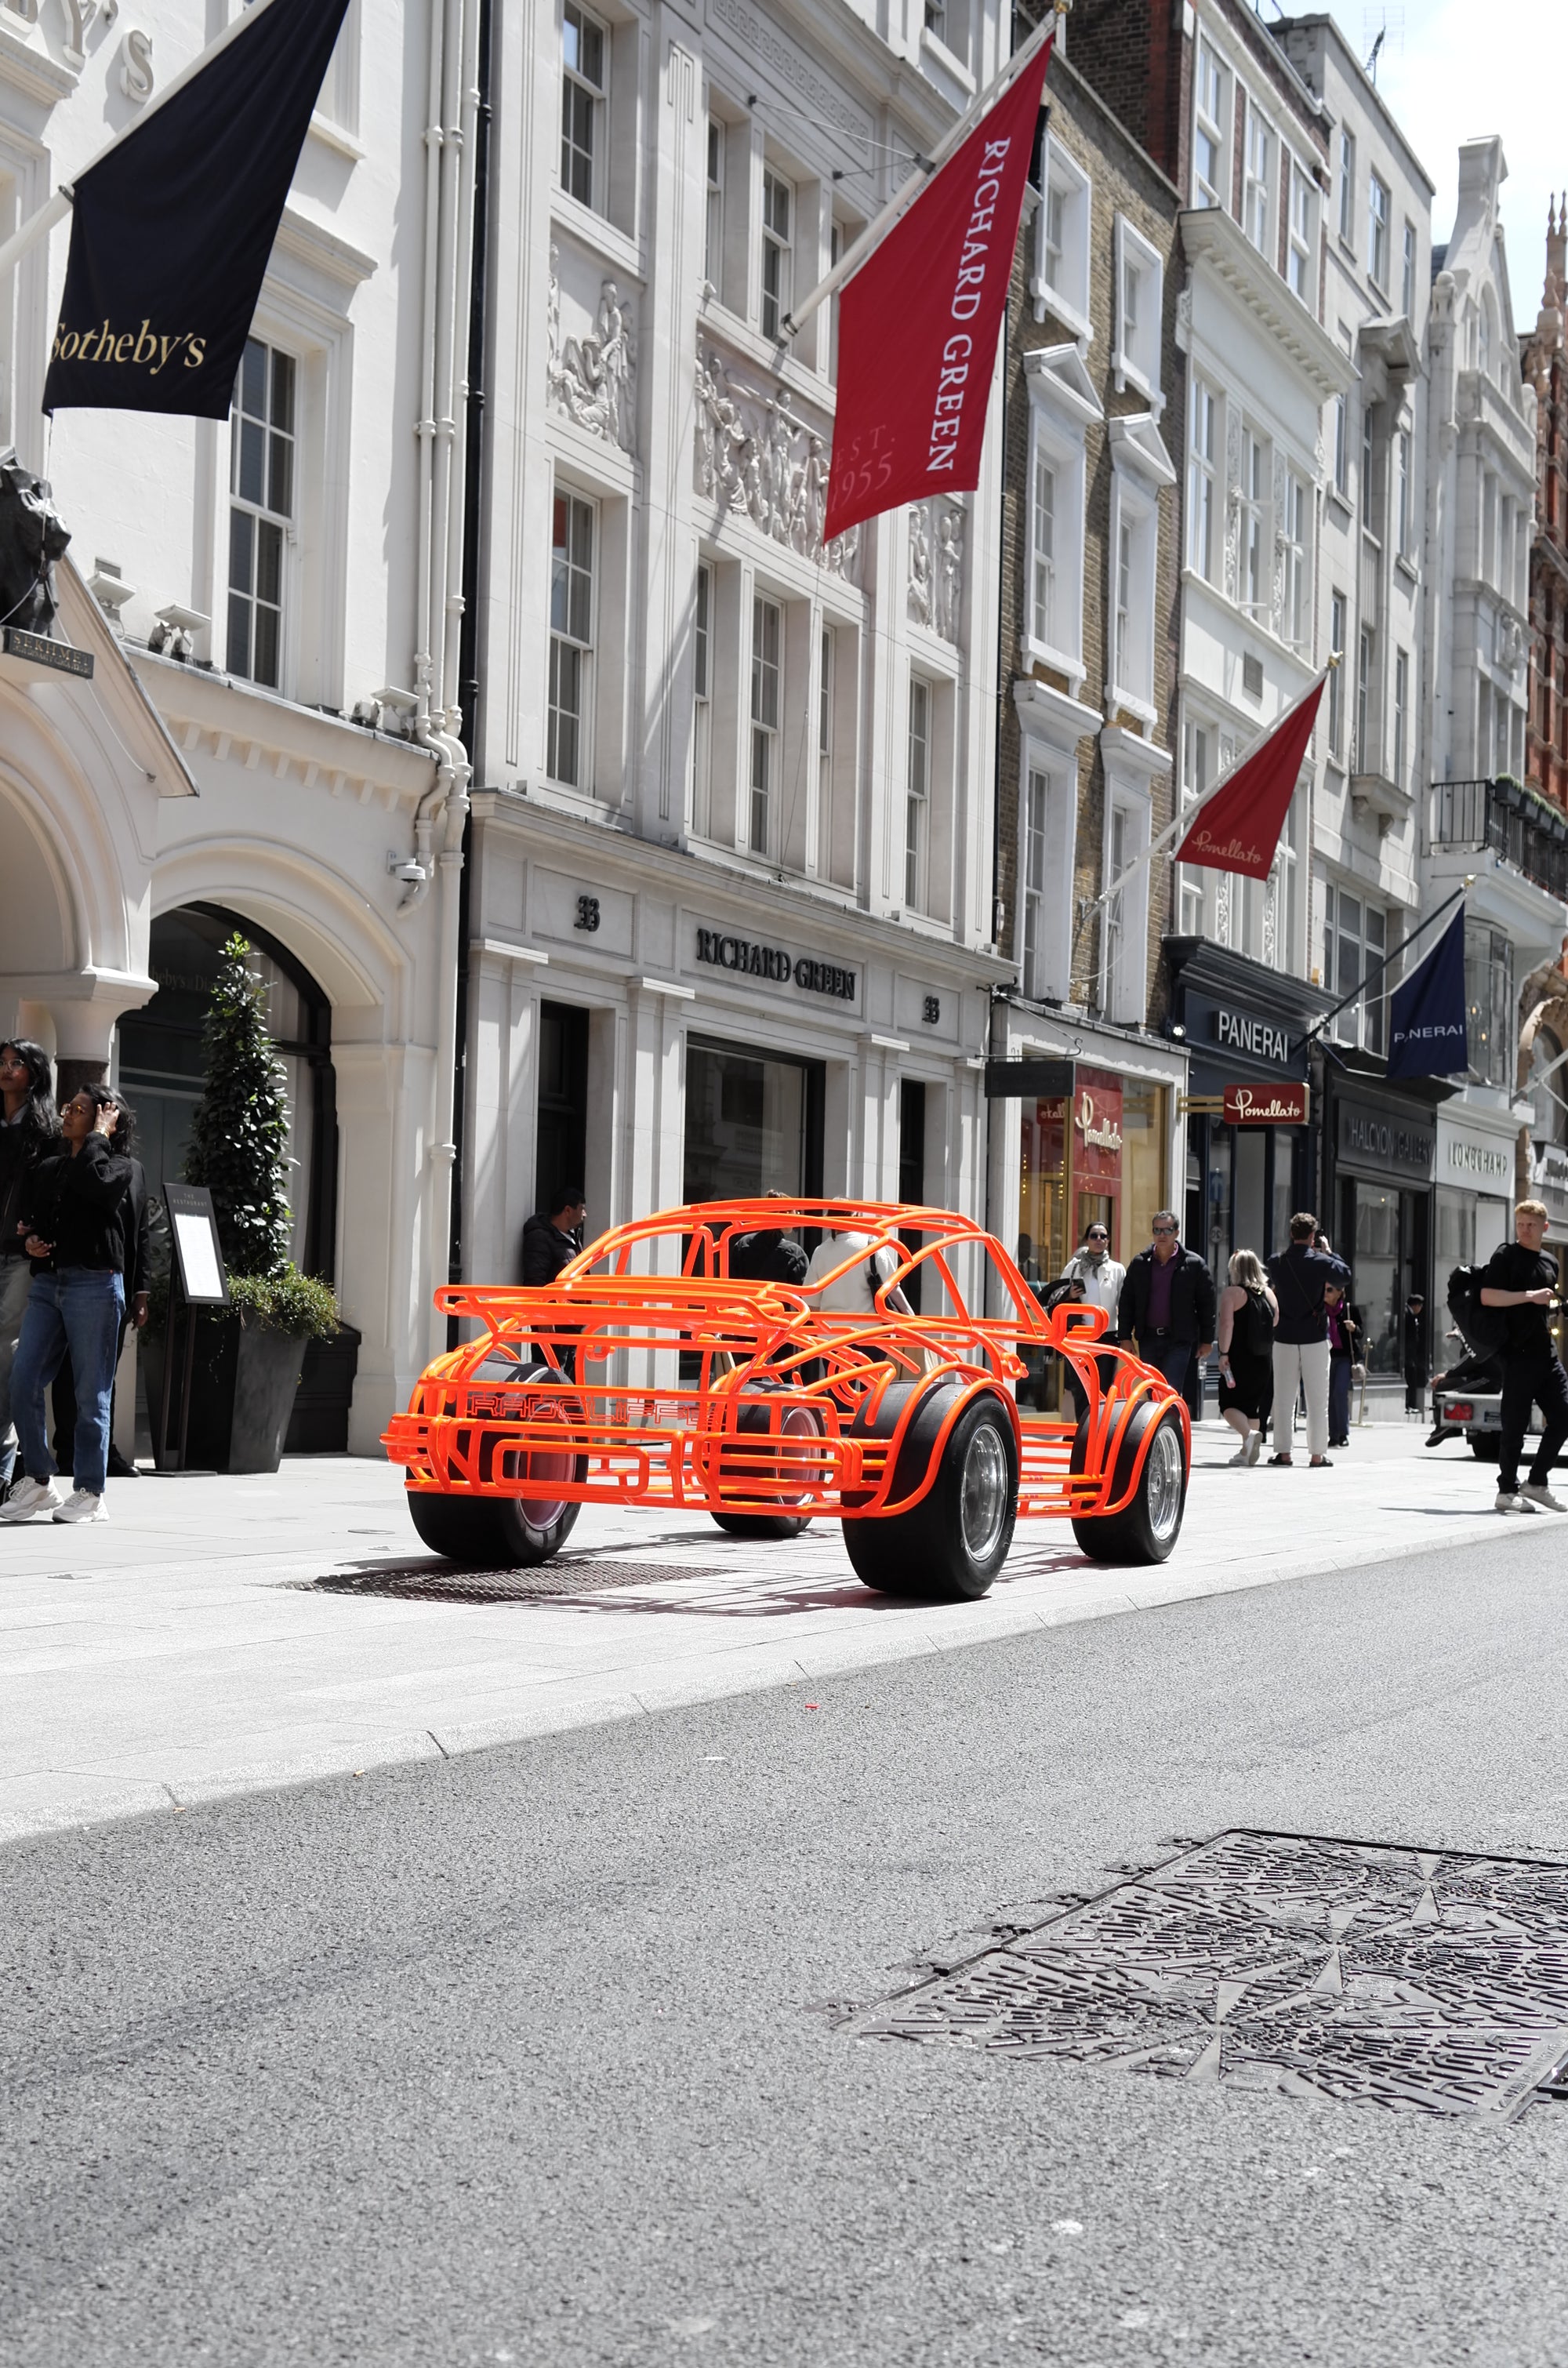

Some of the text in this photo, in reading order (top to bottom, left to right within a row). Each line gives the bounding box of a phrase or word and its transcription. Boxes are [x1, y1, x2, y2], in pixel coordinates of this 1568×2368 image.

[926, 136, 1011, 471] RICHARD GREEN
[831, 451, 892, 514] 1955
[13, 633, 89, 666] SEKHMET
[1191, 830, 1263, 864] Pomellato
[574, 895, 601, 932] 33
[697, 928, 857, 1001] RICHARD GREEN
[922, 995, 940, 1025] 33
[1218, 1010, 1288, 1063] PANERAI
[1394, 1024, 1463, 1044] PNERAI
[1075, 1091, 1123, 1150] Pomellato
[1226, 1088, 1302, 1120] Pomellato
[1348, 1117, 1394, 1156] HALCYON
